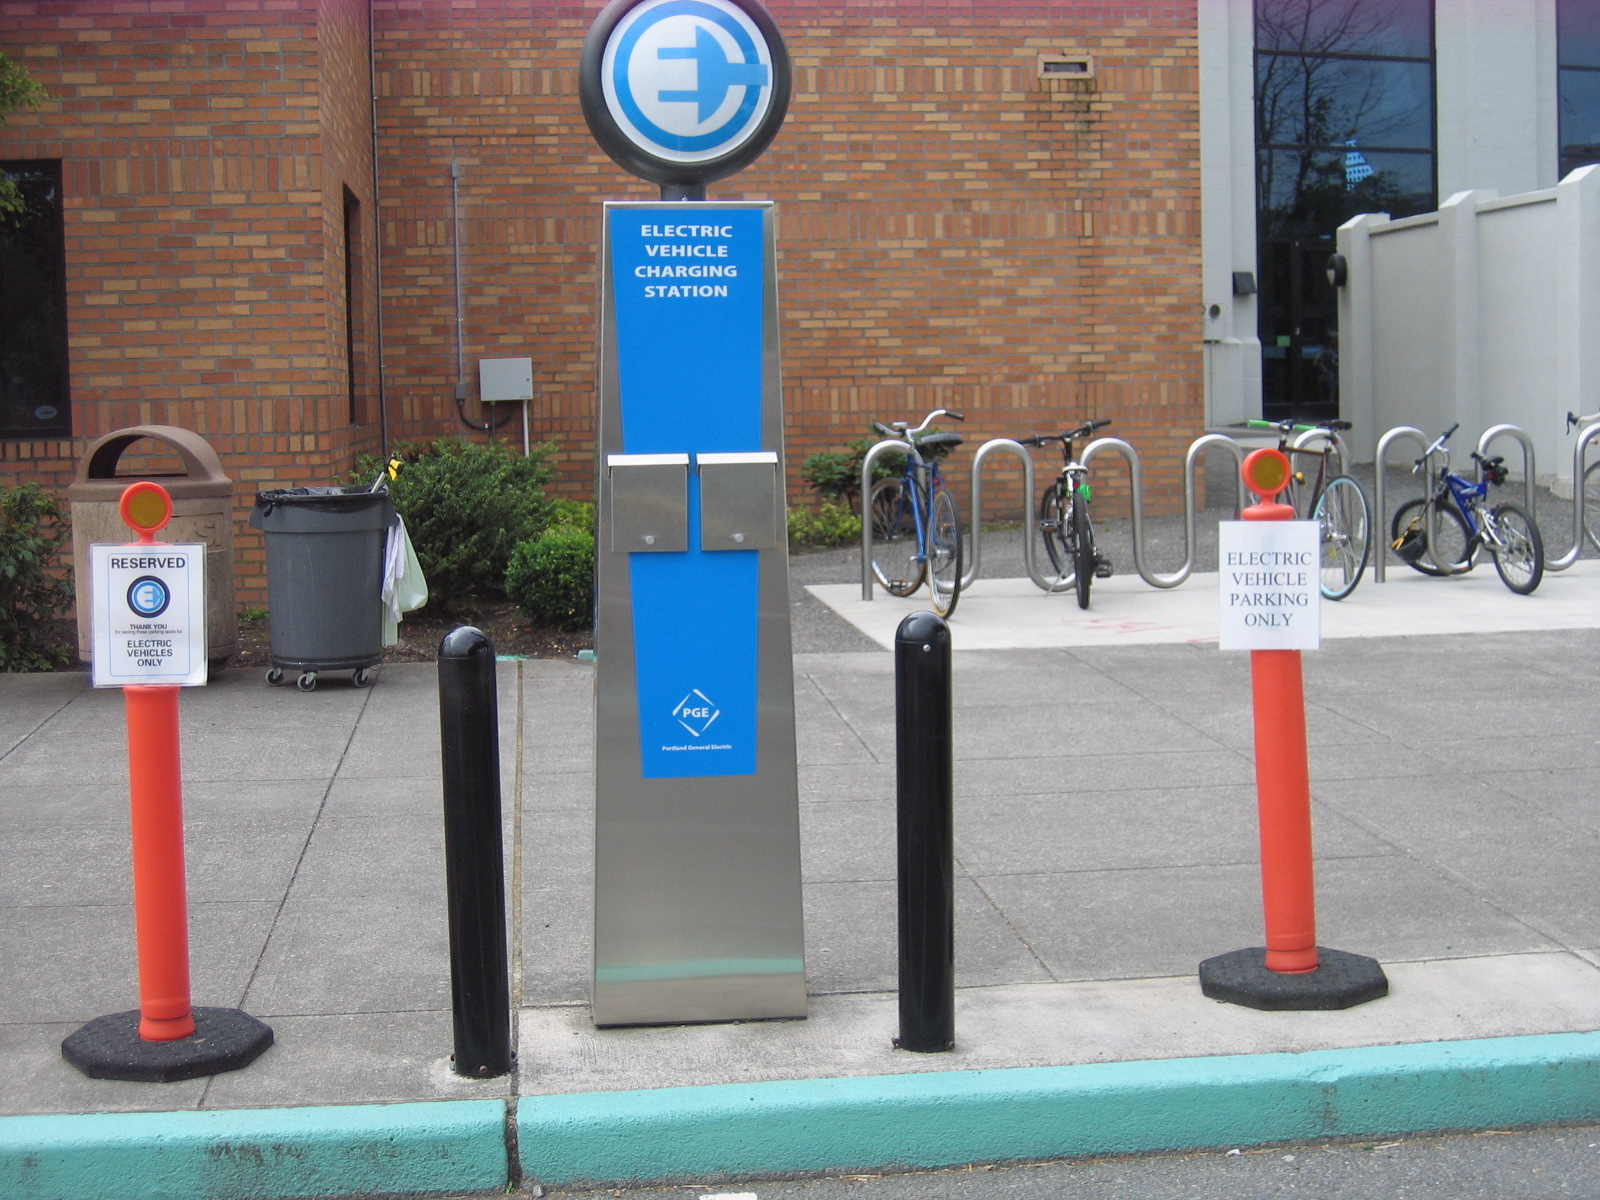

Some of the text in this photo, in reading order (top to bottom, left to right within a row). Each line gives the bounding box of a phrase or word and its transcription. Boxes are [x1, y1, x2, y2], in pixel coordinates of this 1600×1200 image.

[641, 224, 734, 238] ELECTRIC
[645, 244, 729, 258] VEHICLE
[634, 265, 738, 278] CHARGING
[644, 285, 729, 298] STATION
[111, 557, 186, 569] RESERVED
[1227, 551, 1312, 566] ELECTRIC
[1232, 572, 1308, 586] VEHICLE
[1230, 592, 1309, 607] PARKING
[1244, 612, 1294, 627] ONLY
[127, 640, 172, 648] ELECTRIC
[127, 649, 173, 657] VEHICLES
[137, 658, 163, 667] ONLY
[683, 707, 709, 718] PGE
